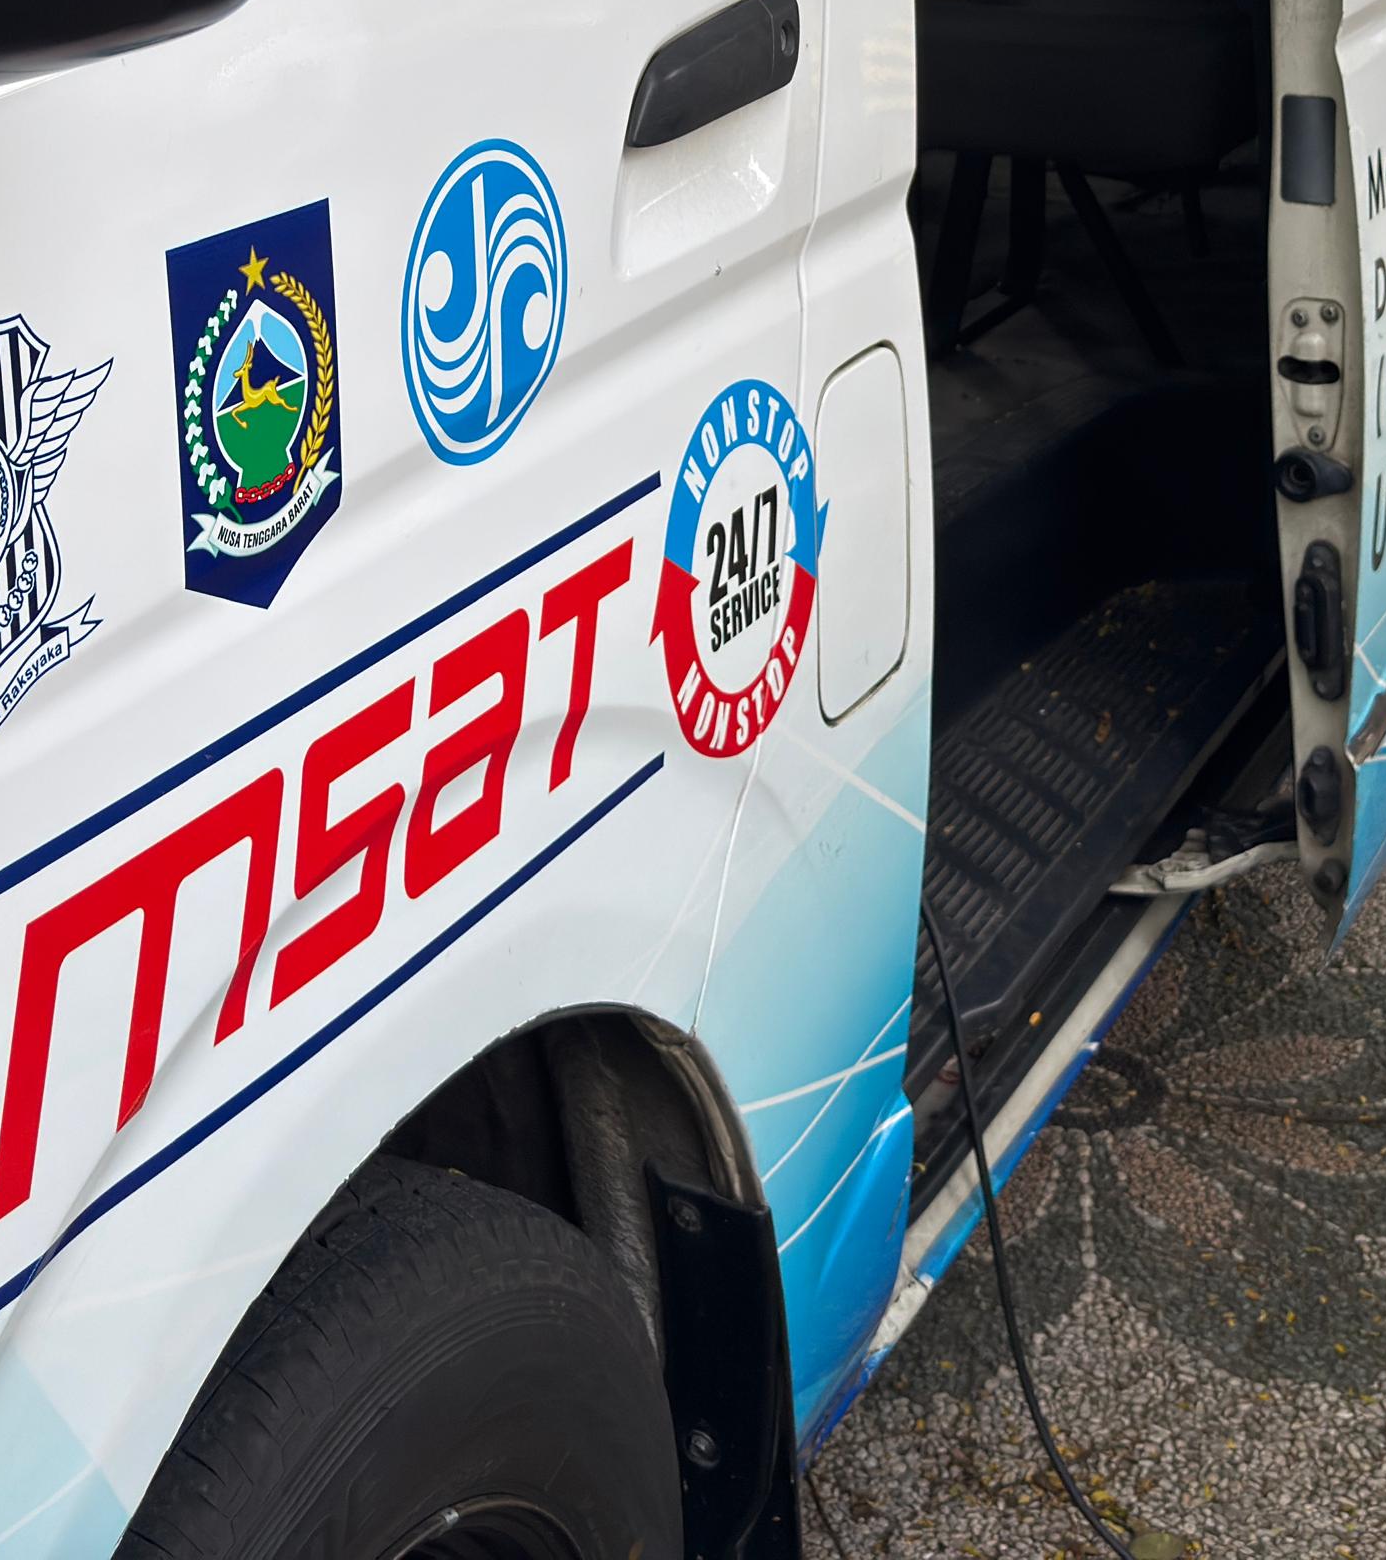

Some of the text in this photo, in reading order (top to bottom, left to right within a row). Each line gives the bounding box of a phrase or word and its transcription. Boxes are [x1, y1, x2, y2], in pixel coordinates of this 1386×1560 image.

[682, 388, 810, 504] NONSTOP
[218, 482, 314, 549] NUSA TENGGARA BARAT
[706, 484, 778, 608] 24/7
[711, 565, 780, 652] SERVICE
[0, 644, 63, 711] Raksyaka
[677, 626, 796, 750] NONSTOP
